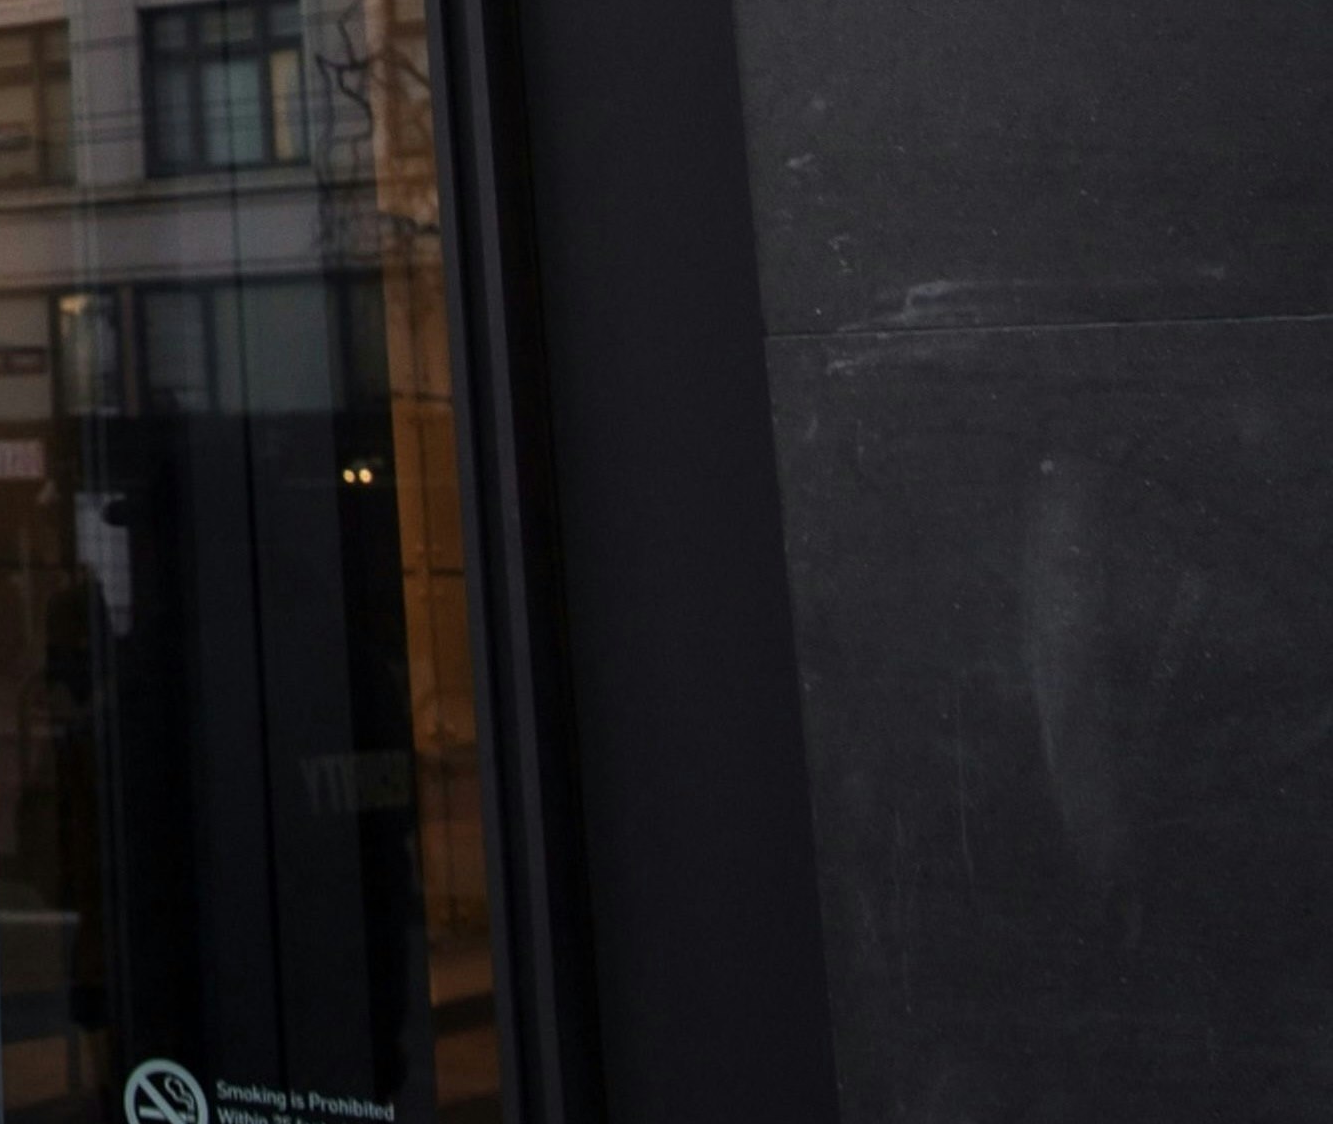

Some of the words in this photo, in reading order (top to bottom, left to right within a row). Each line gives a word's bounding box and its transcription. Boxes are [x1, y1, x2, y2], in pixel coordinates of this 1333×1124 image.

[215, 1079, 287, 1112] Smoking
[290, 1089, 305, 1111] is
[307, 1090, 395, 1123] Prohibited
